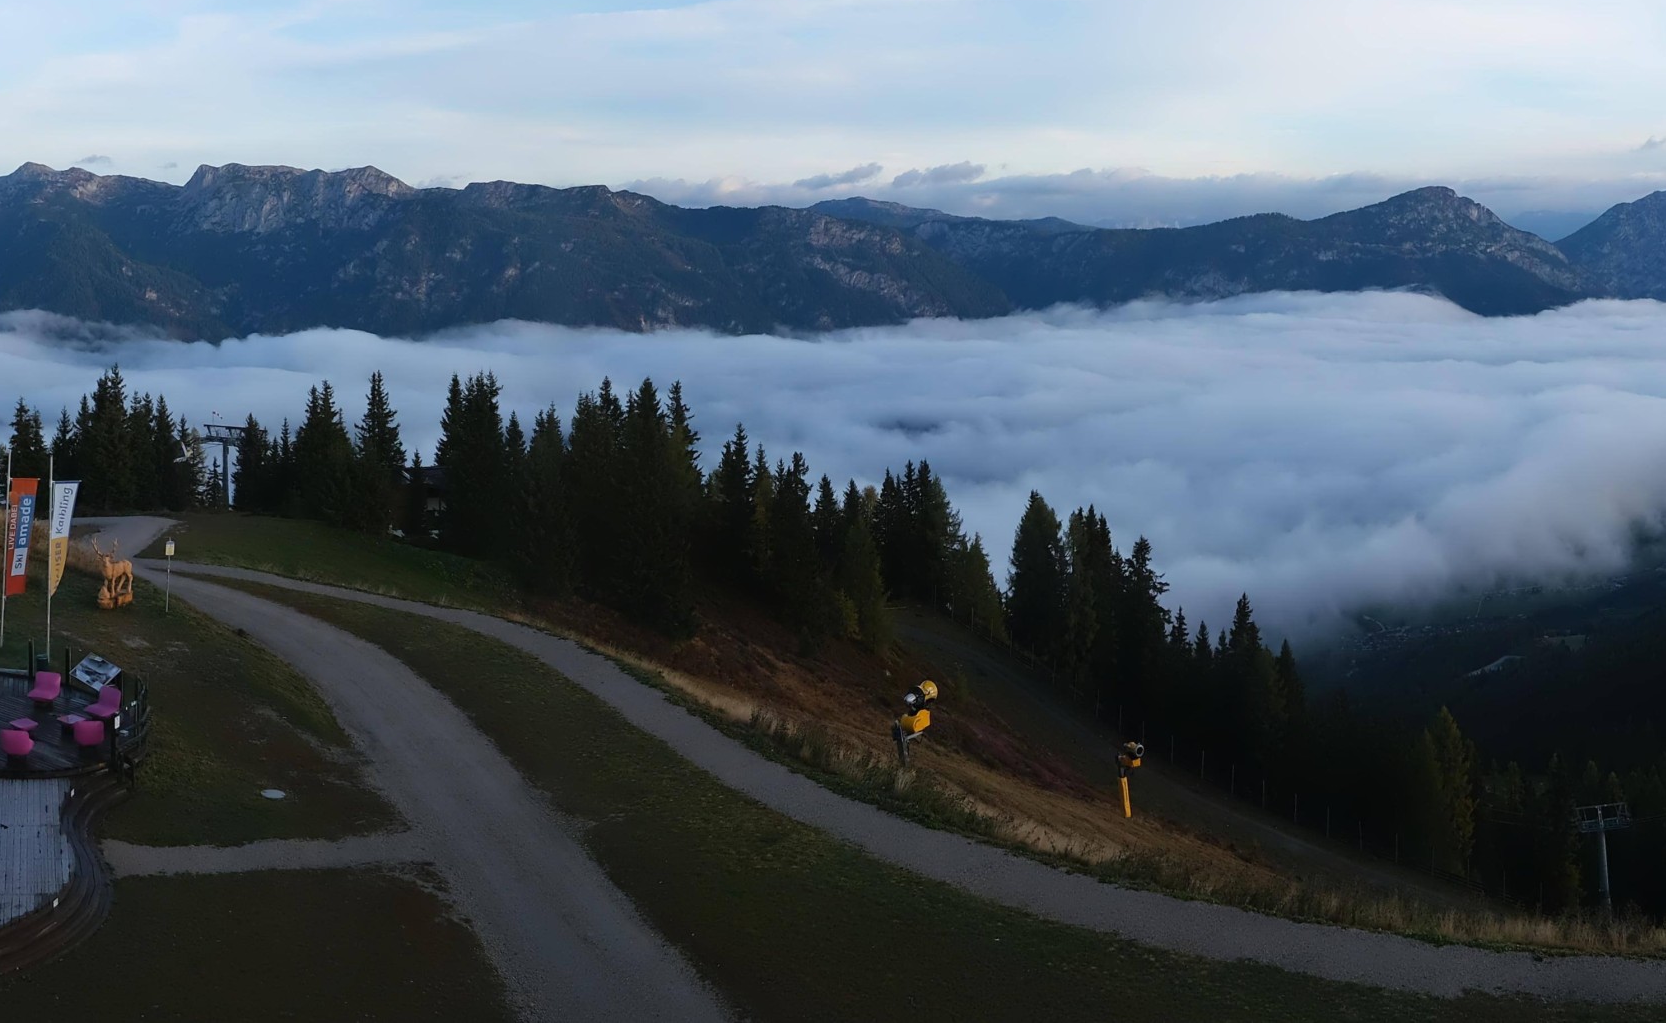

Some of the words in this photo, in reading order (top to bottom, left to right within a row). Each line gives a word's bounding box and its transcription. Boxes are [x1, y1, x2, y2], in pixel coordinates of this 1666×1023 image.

[10, 504, 18, 530] DABEI
[55, 487, 74, 534] Kaibling
[8, 530, 16, 550] LIVE
[14, 554, 23, 569] Ski
